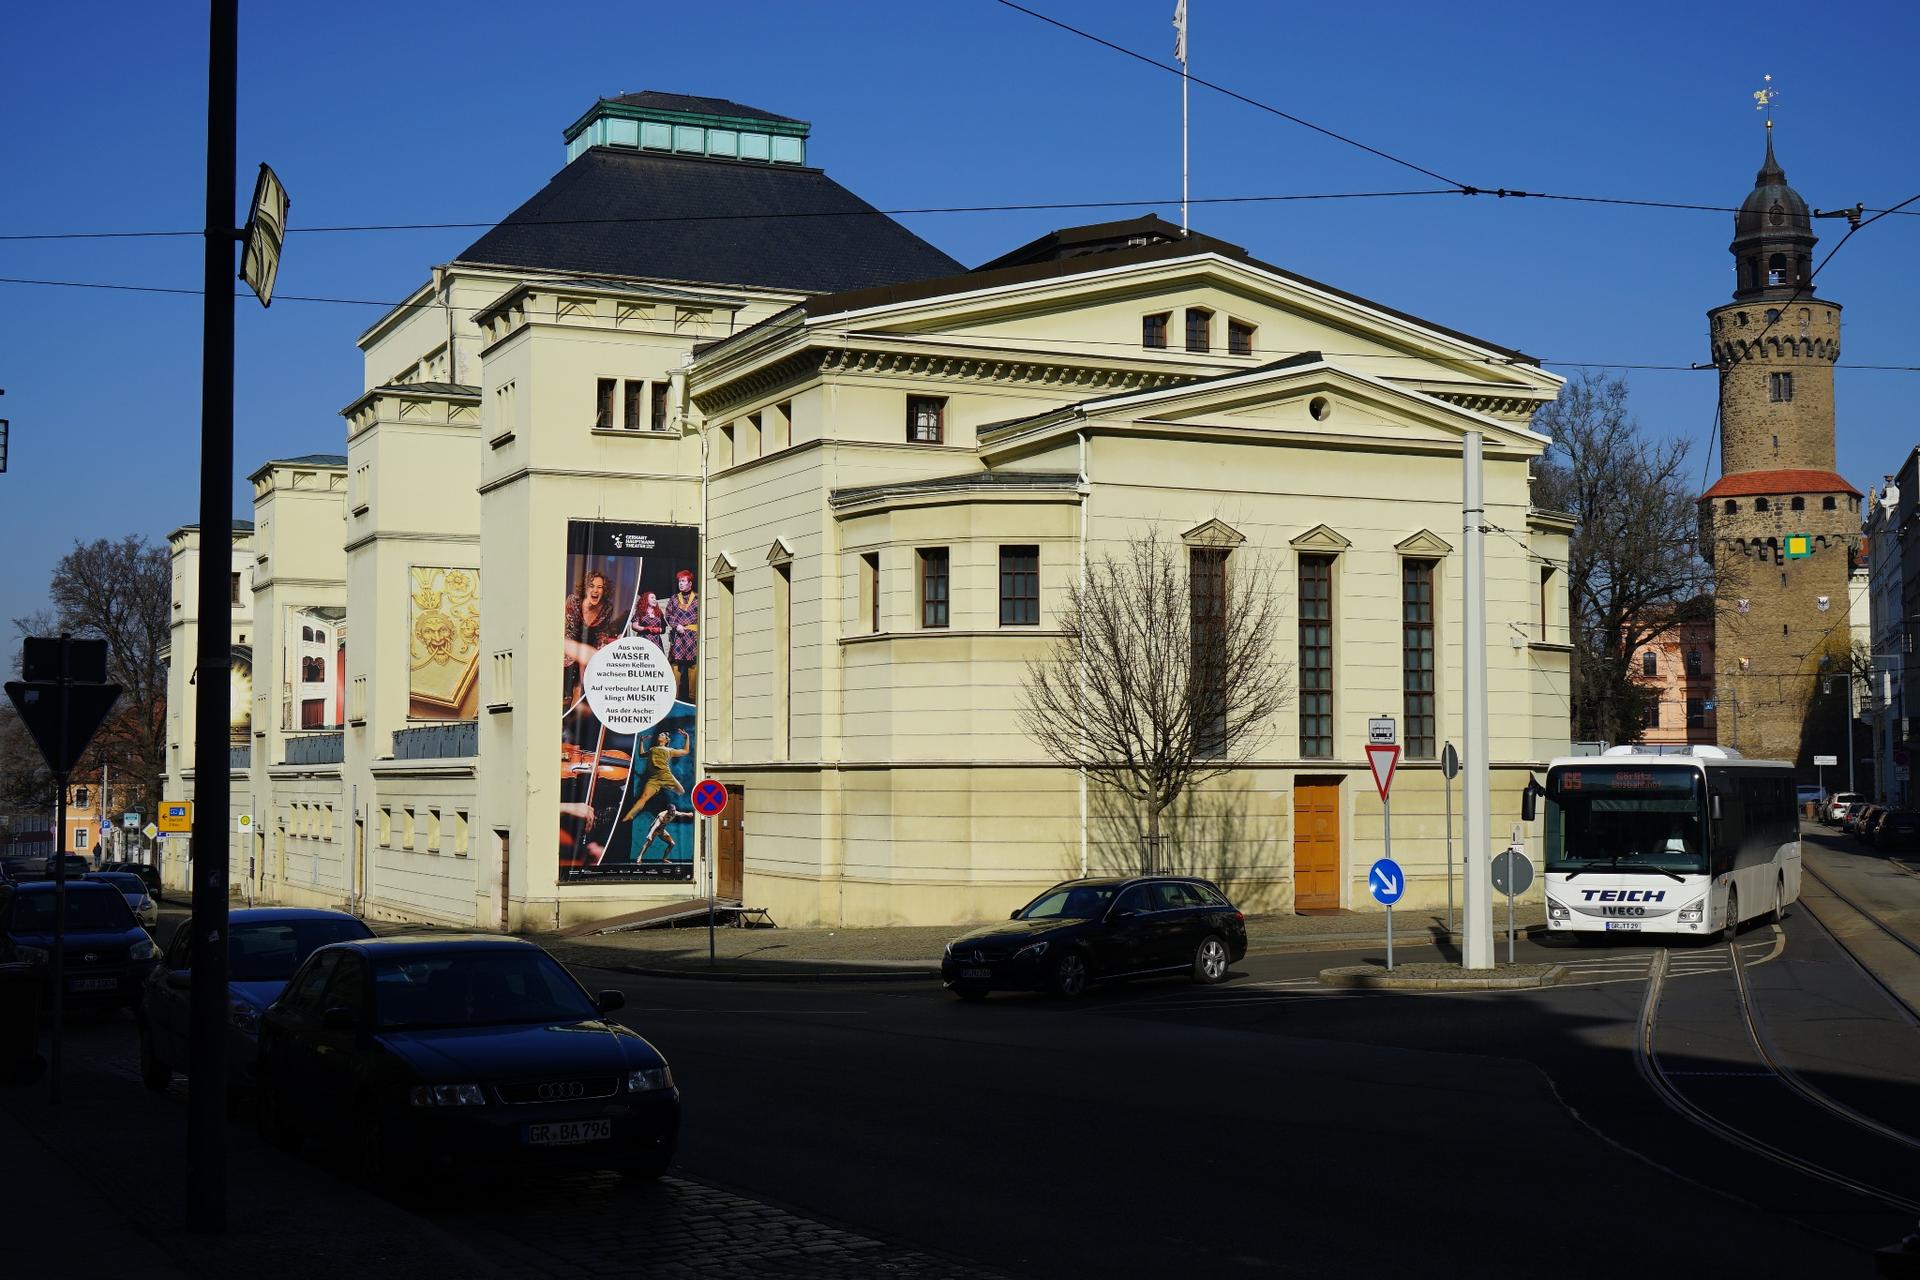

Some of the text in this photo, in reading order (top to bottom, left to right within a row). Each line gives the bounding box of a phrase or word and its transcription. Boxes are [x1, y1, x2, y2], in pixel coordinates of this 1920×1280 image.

[612, 652, 650, 661] WASSER
[627, 670, 664, 678] BLUMEN
[641, 684, 669, 693] LAUTE
[604, 694, 656, 702] klingt MUSIK
[608, 715, 652, 723] PHOENIX!
[1581, 889, 1666, 902] TEICH
[1602, 906, 1646, 916] IVECO
[560, 1124, 580, 1140] BA
[582, 1121, 609, 1138] 796
